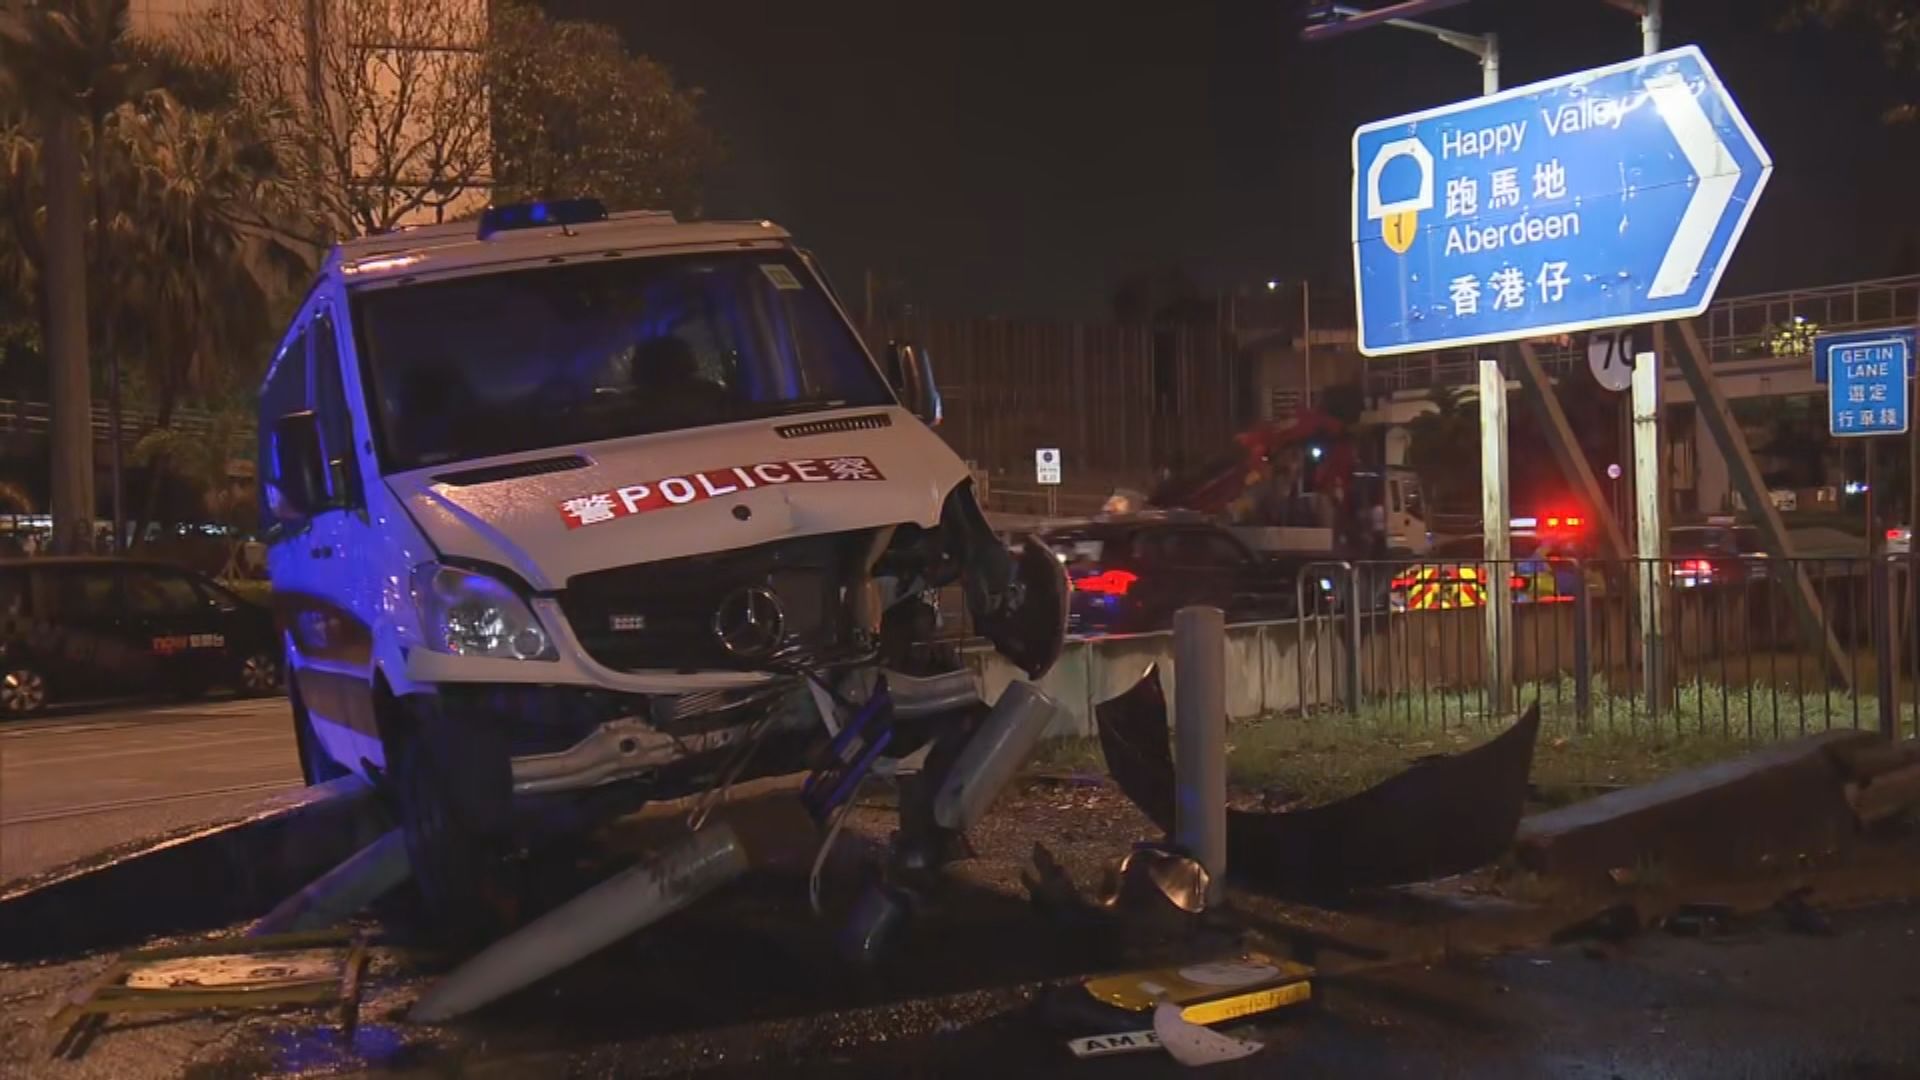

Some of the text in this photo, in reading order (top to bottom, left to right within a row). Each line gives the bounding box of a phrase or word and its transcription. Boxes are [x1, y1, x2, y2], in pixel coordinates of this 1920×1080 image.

[1442, 95, 1626, 161] Happy Valley
[1444, 157, 1568, 219] 跑馬地
[1444, 211, 1580, 257] Aberdeen
[1449, 261, 1571, 317] 香港仔
[1841, 348, 1872, 363] GET
[1873, 346, 1893, 361] IN
[1847, 362, 1888, 378] LANE
[616, 459, 829, 514] POLICE
[1086, 1034, 1136, 1052] AM
